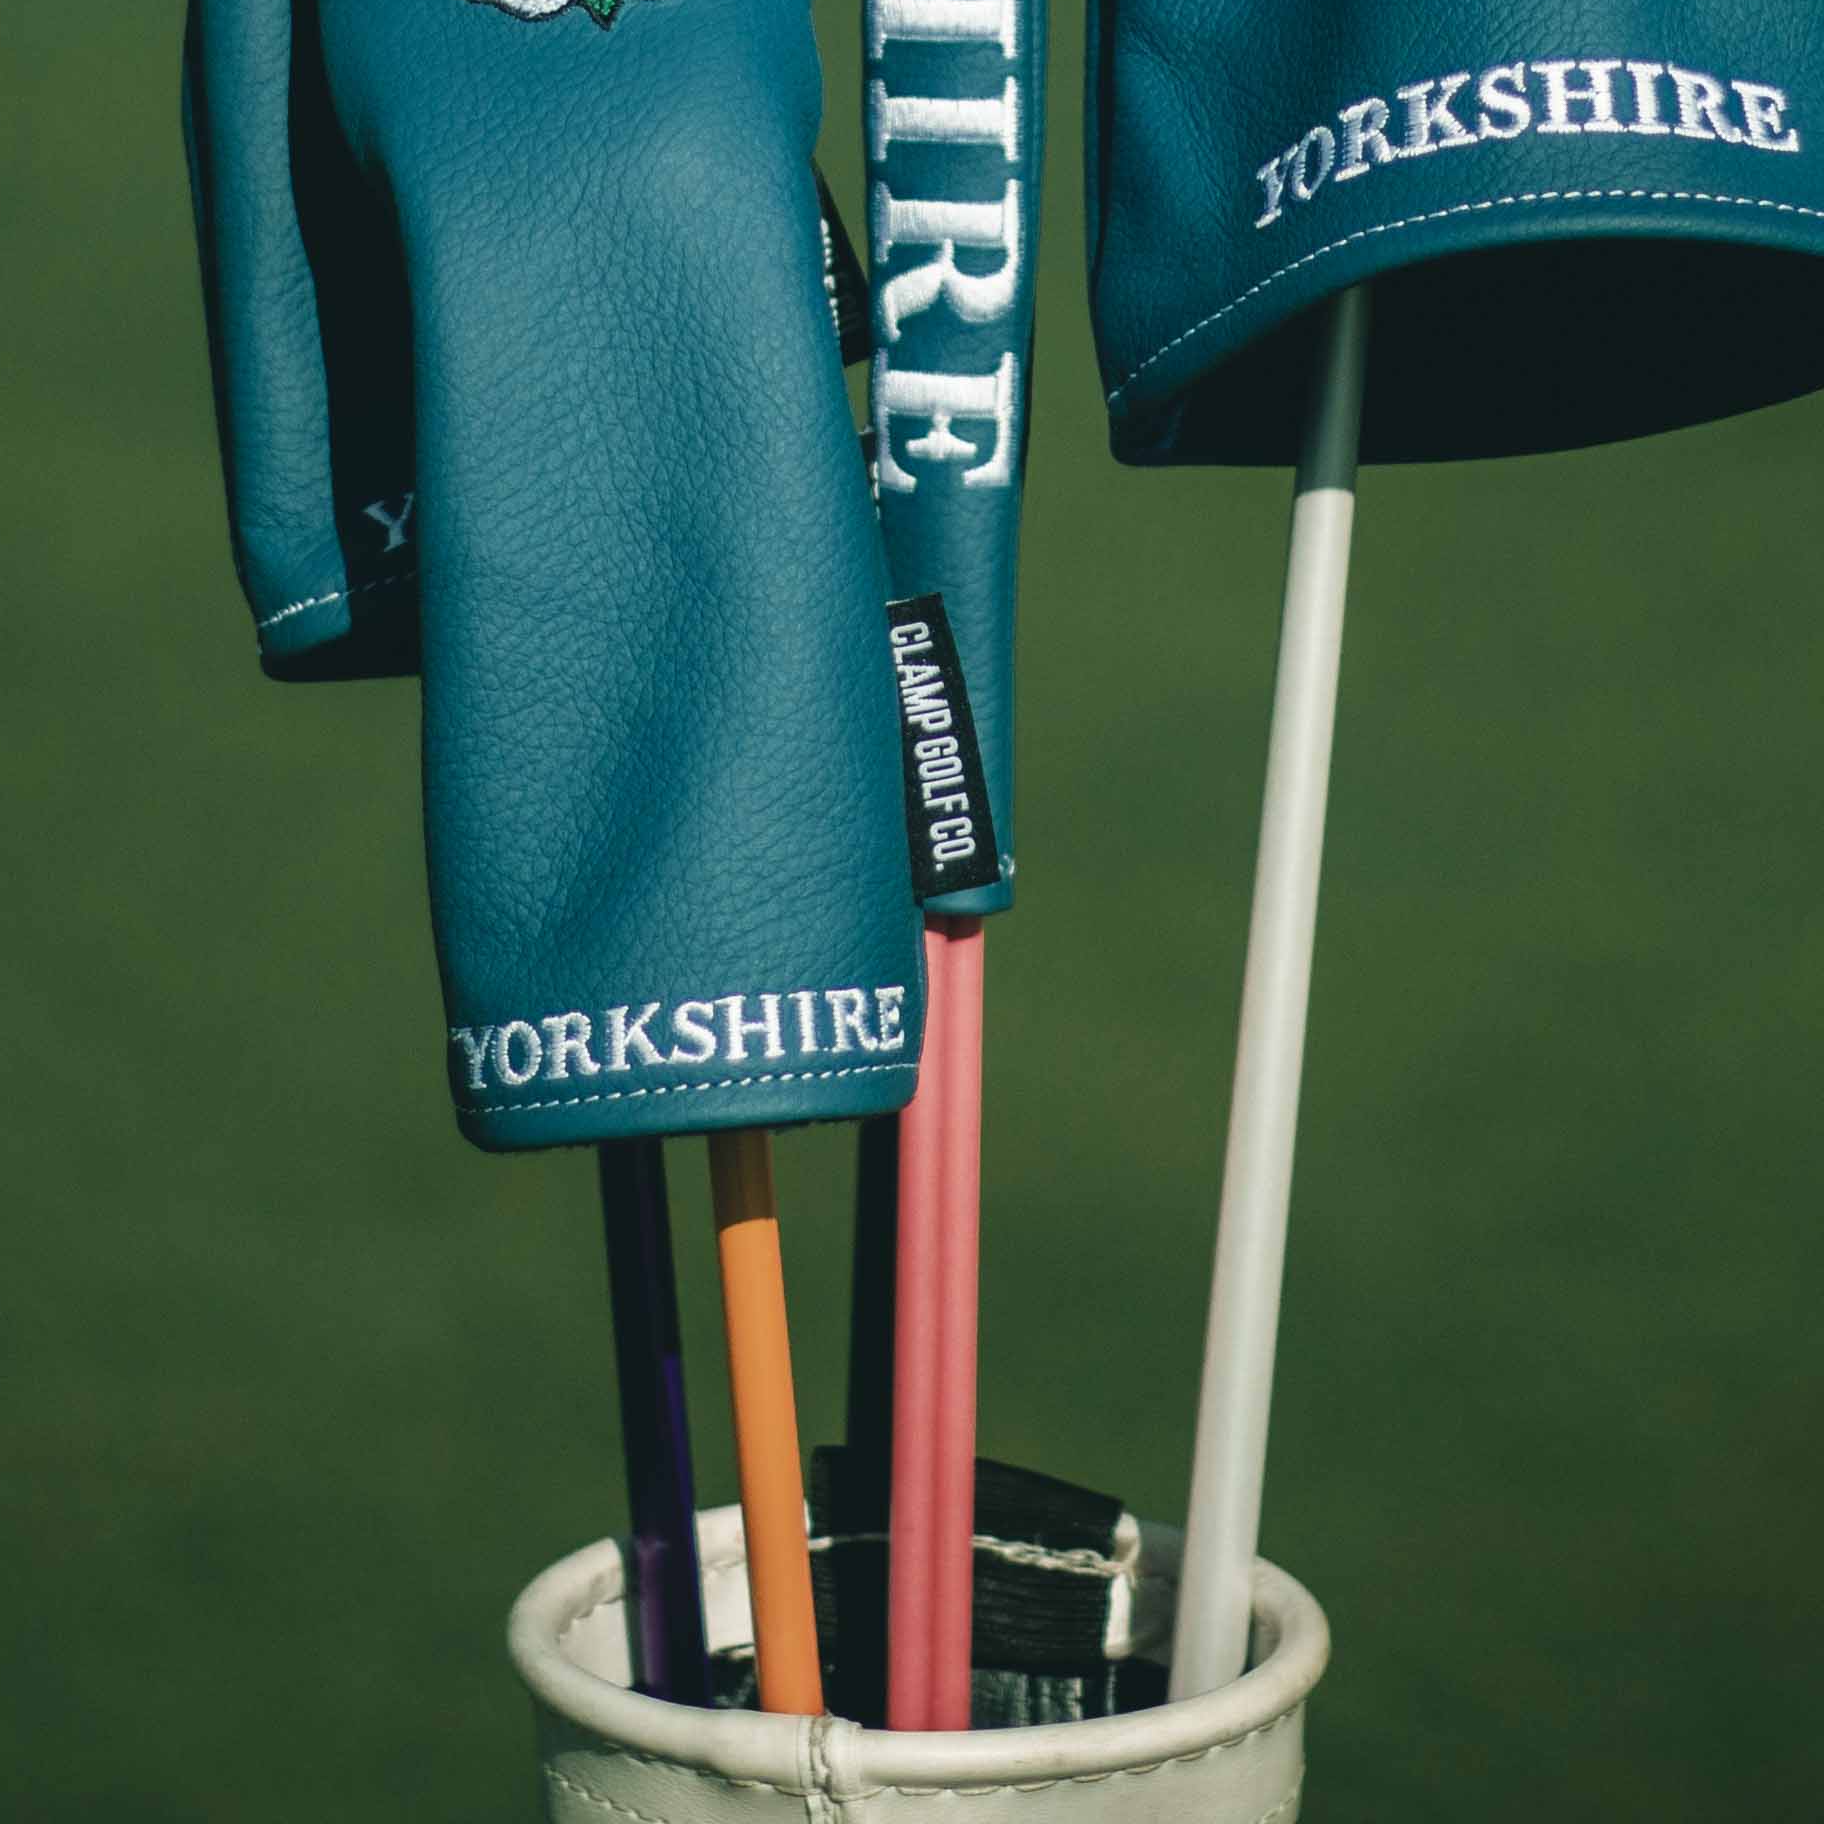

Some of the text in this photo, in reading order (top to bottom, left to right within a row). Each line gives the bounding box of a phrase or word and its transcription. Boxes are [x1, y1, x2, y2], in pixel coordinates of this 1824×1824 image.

[1255, 59, 1801, 230] YORKSHIRE
[889, 621, 977, 872] CLAMP GOLF CO.
[450, 985, 906, 1090] YORKSHIRE
